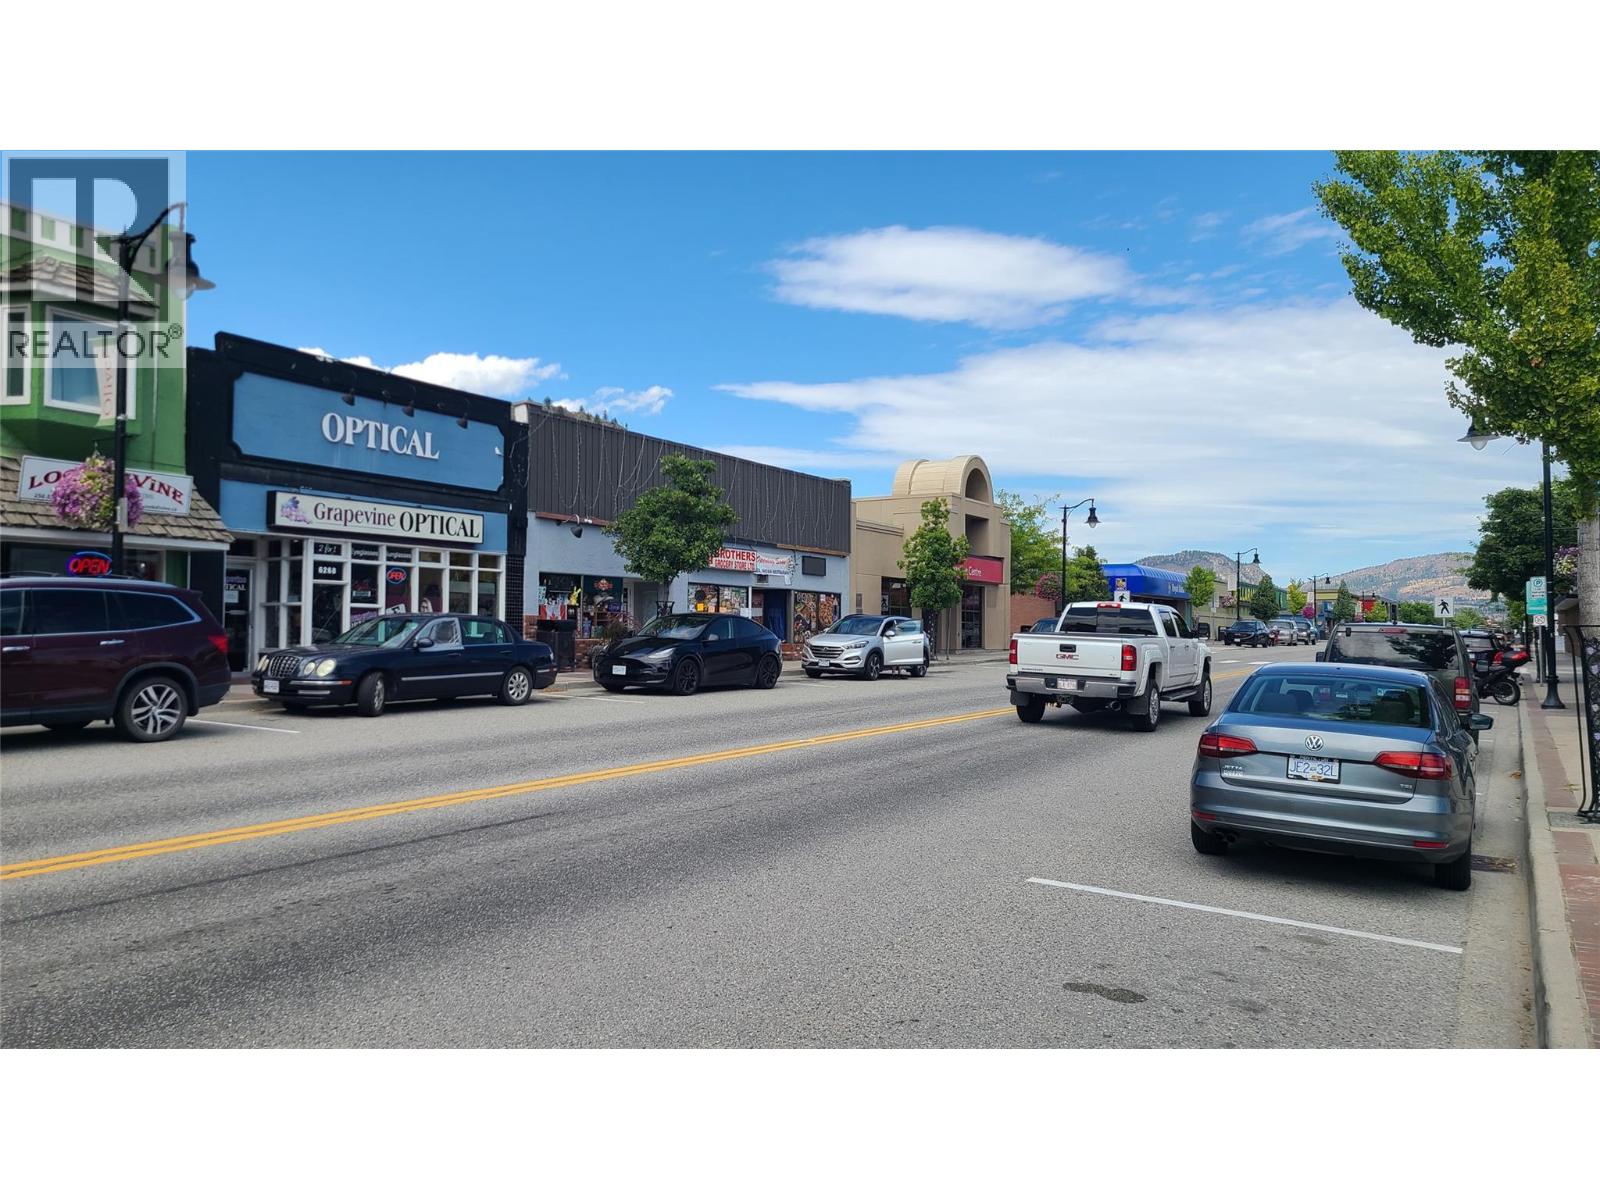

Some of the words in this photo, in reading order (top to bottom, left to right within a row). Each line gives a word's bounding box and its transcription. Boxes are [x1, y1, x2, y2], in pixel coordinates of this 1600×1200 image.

[321, 412, 440, 460] OPTICAL
[313, 502, 396, 527] Grapevine
[399, 510, 480, 539] OPTICAL
[714, 548, 756, 562] BROTHERS
[69, 558, 110, 575] OPEN
[1055, 653, 1079, 661] GMC
